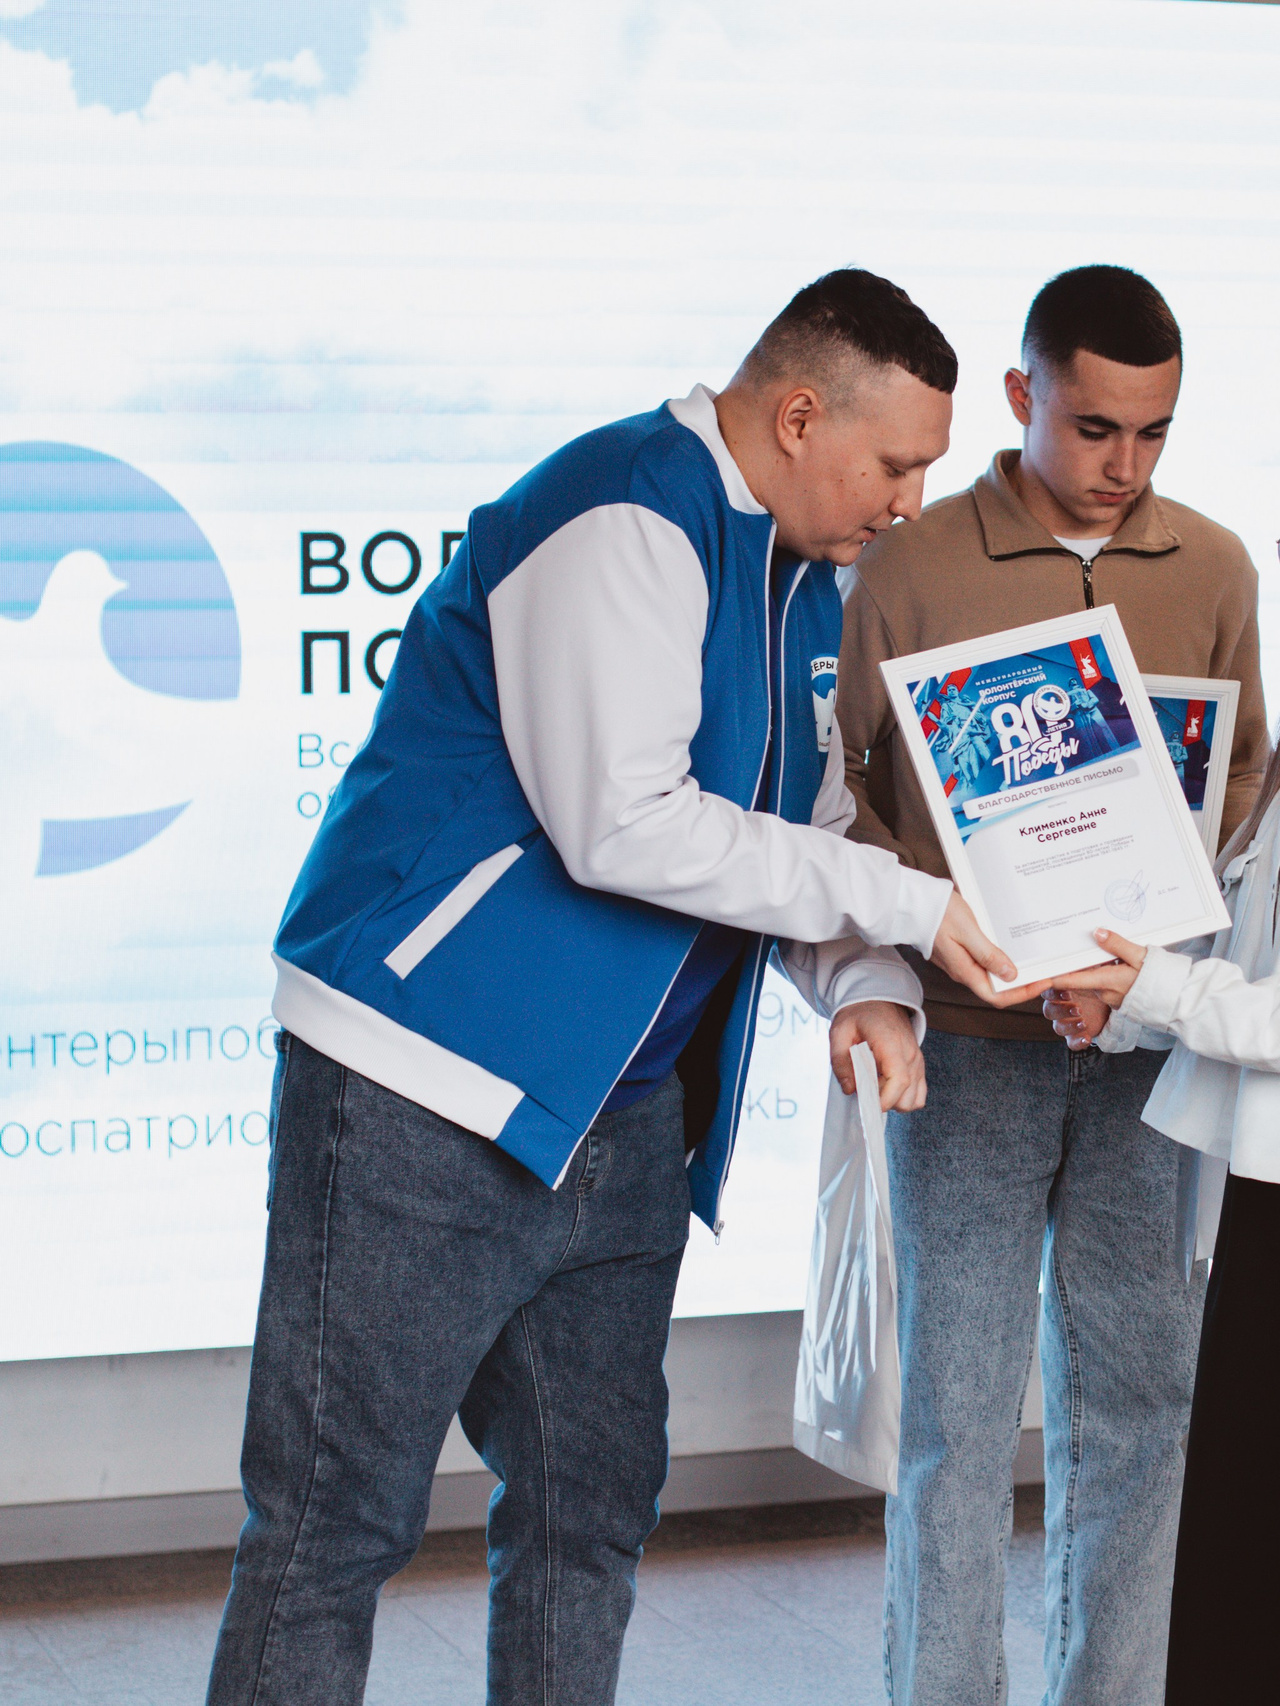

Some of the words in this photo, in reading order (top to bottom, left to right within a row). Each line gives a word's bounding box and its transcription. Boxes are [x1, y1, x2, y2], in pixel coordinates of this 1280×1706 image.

[300, 530, 467, 595] ВО
[975, 665, 1043, 686] МЕЖДУНАРОДНЫЙ
[979, 672, 1047, 697] ВОЛОНТЁРСКИЙ
[982, 691, 1017, 706] КОРПУС
[299, 733, 362, 768] Вс
[992, 737, 1080, 785] Победы
[978, 777, 1082, 810] БЛАГОДАРСТВЕННОЕ
[1083, 765, 1124, 782] ПИСЬМО
[1018, 815, 1077, 837] Клименко
[1079, 806, 1108, 821] Анне
[1037, 821, 1097, 843] Сергеевне
[0, 1015, 277, 1076] нтерыпоб
